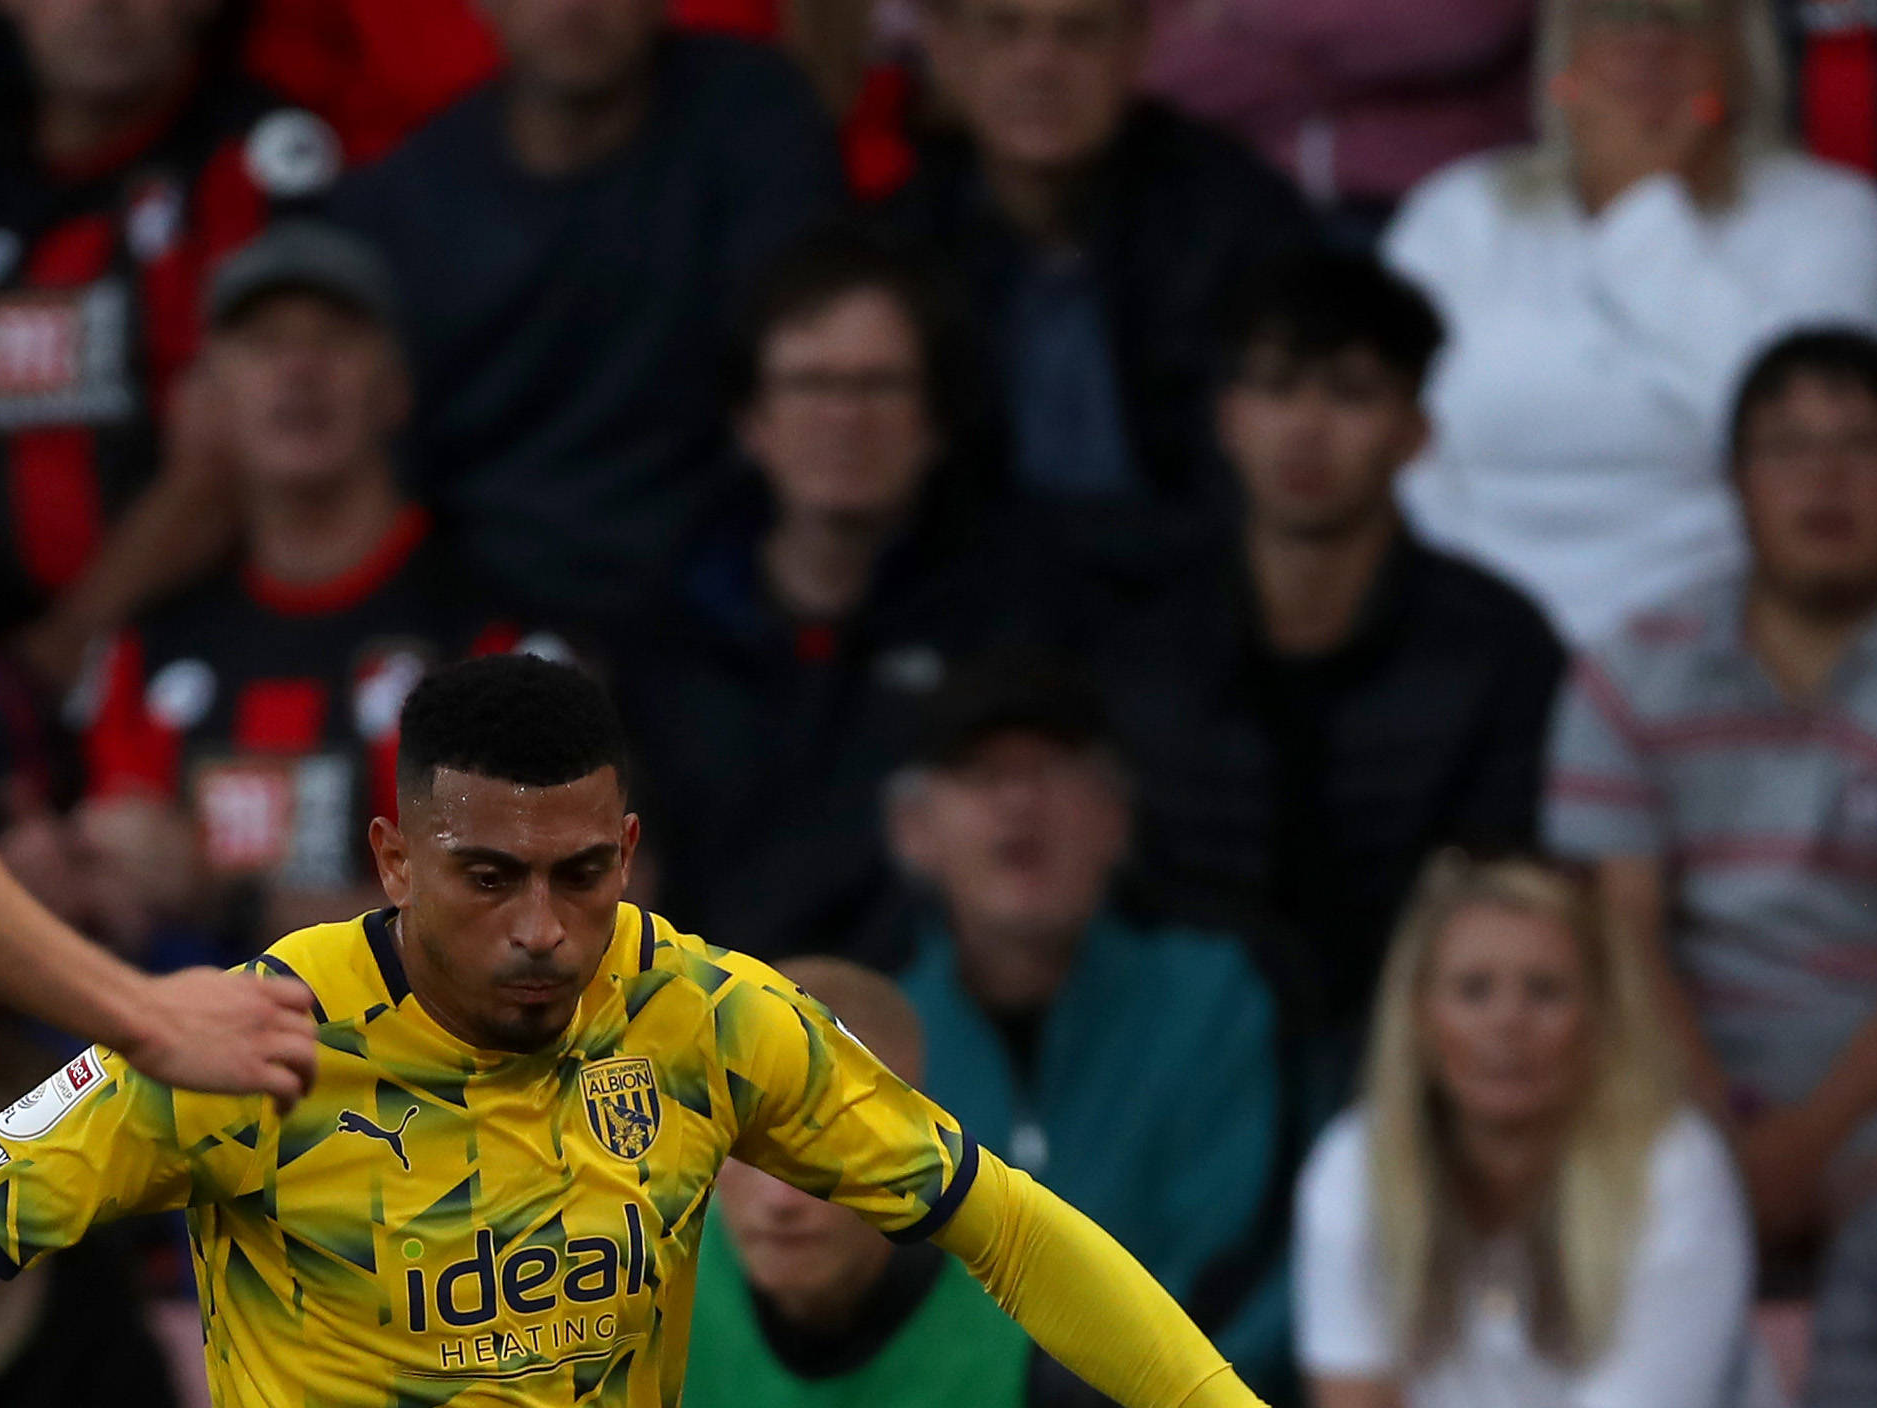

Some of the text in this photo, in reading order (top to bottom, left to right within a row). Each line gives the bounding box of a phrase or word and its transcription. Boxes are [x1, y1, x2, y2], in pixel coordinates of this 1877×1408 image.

[590, 1071, 651, 1096] ALBION
[401, 1202, 646, 1333] ideal
[441, 1313, 618, 1368] HEATING
